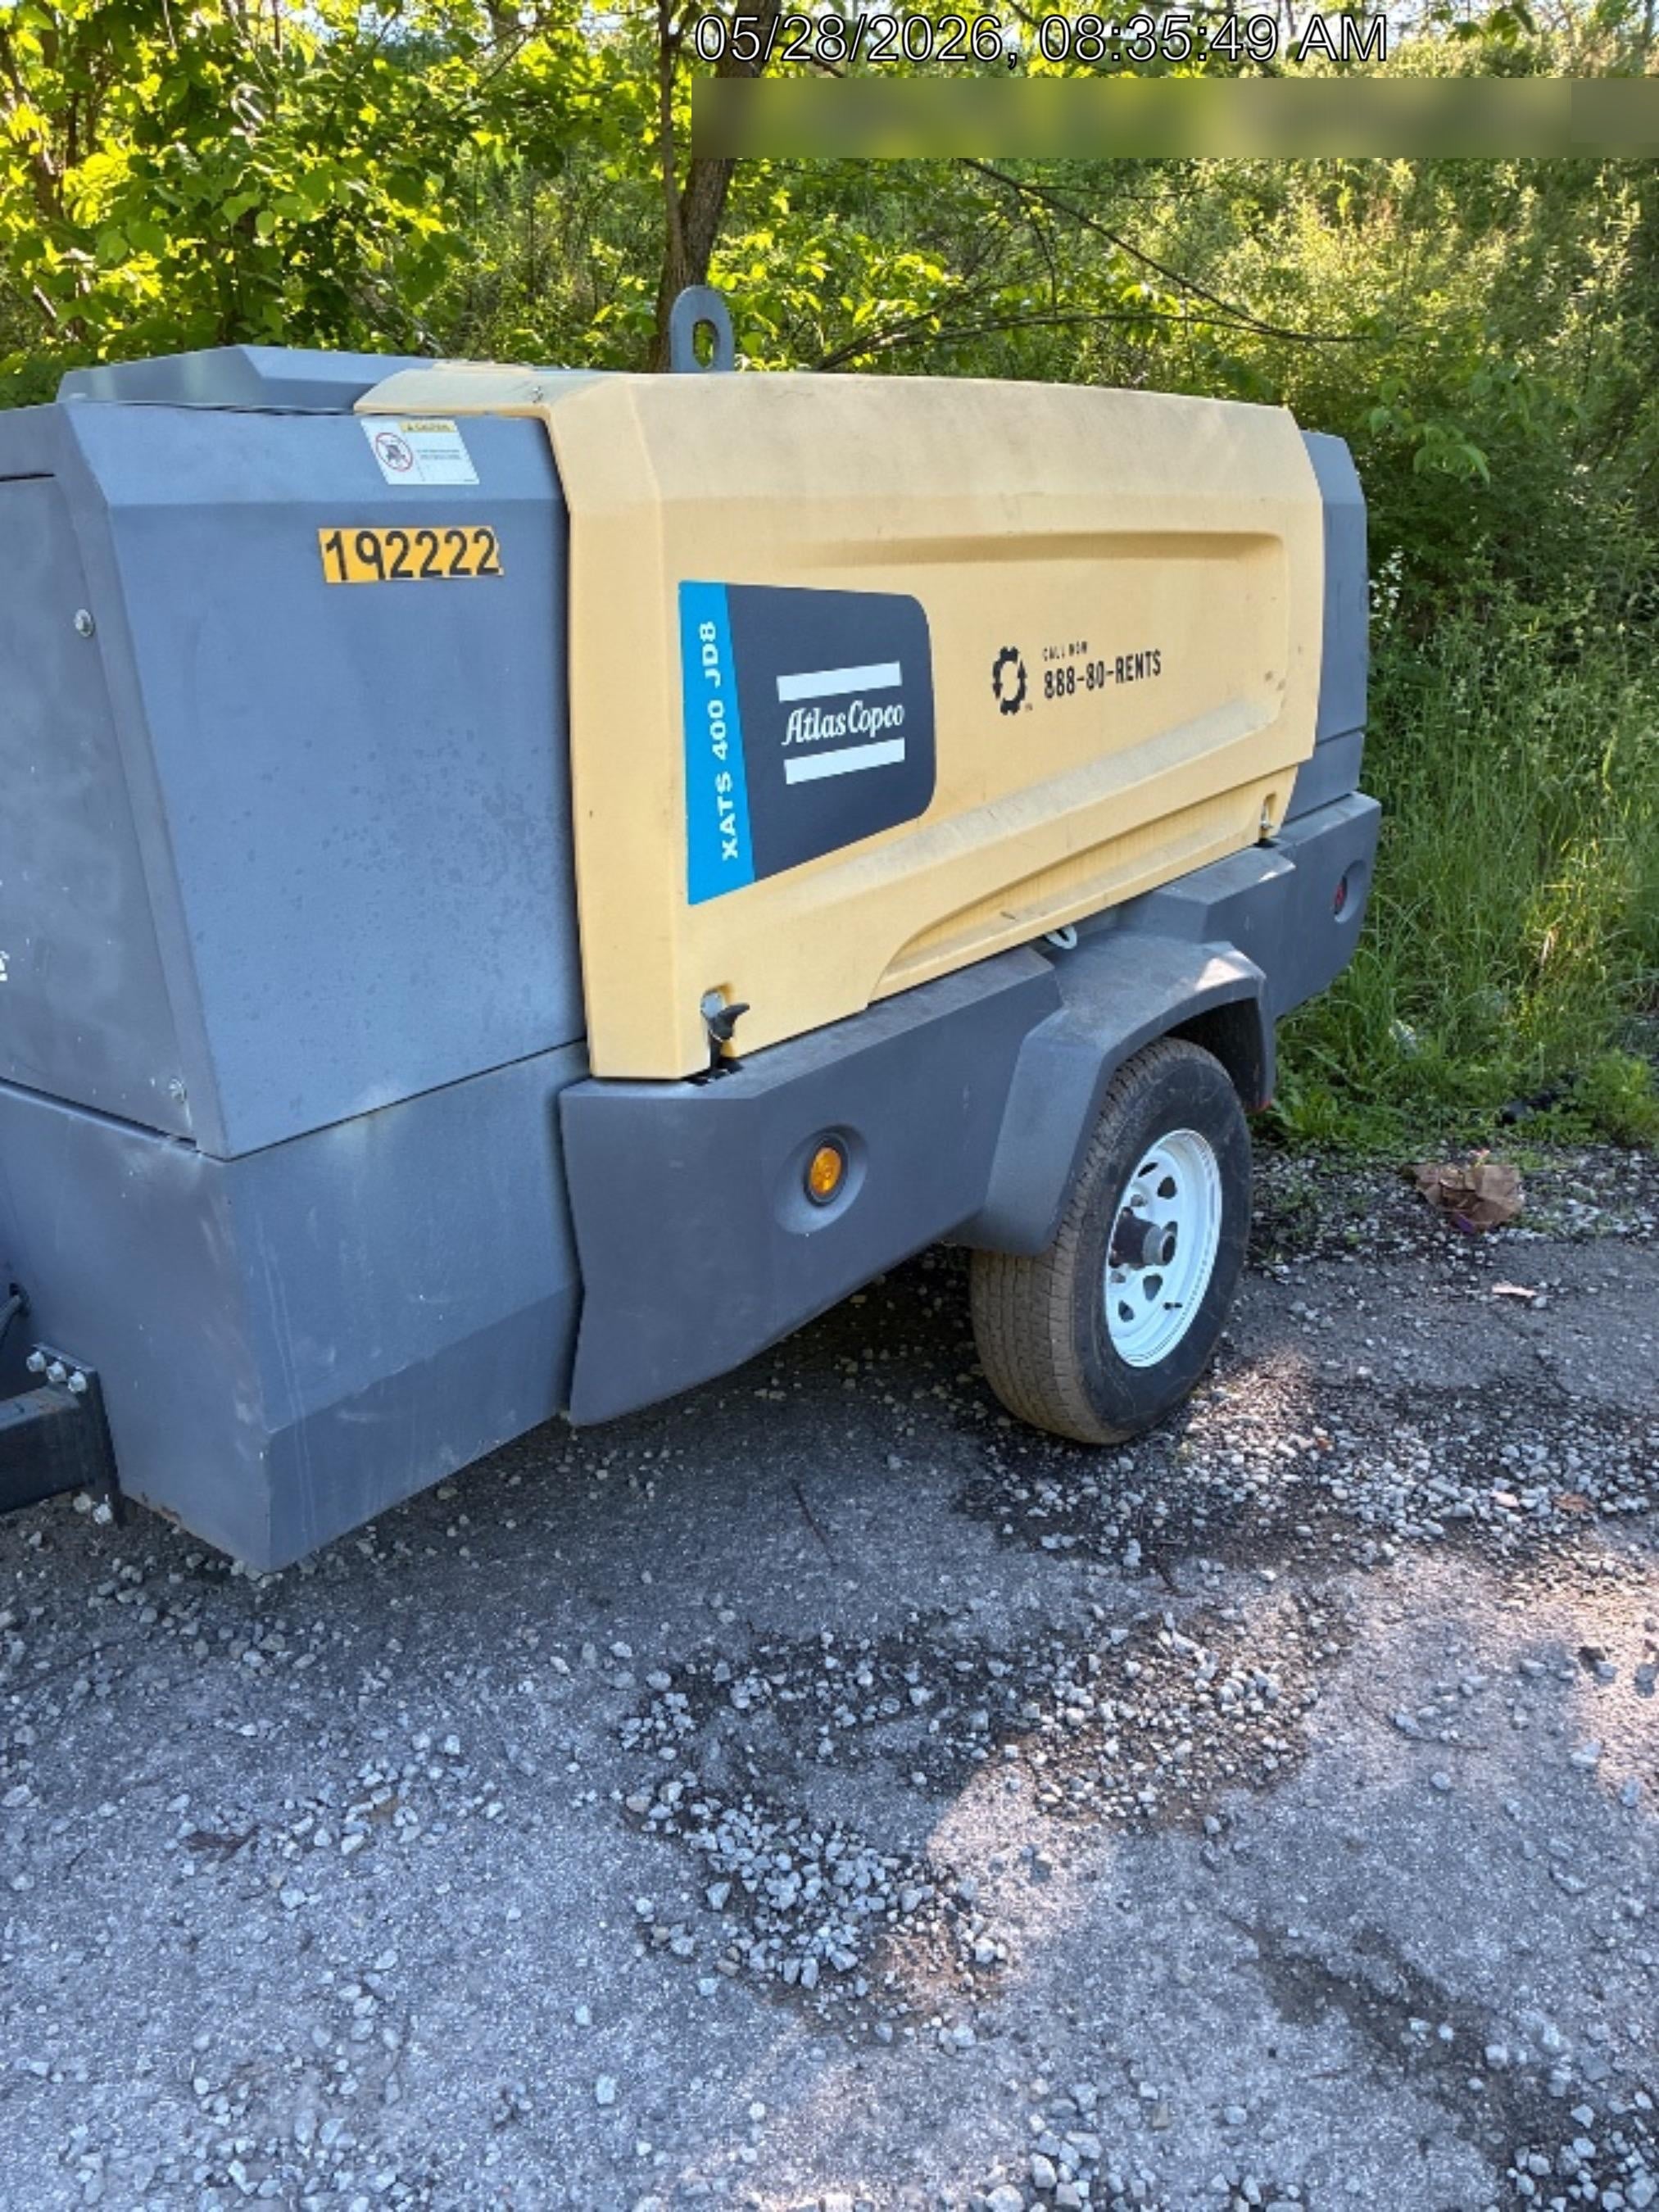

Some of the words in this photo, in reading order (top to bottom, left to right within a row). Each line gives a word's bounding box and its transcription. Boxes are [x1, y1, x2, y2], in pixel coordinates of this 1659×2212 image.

[325, 528, 500, 581] 192222
[699, 621, 722, 688] JD8
[1044, 649, 1162, 699] 888-80-RENTS
[707, 700, 728, 760] 400
[715, 773, 738, 861] XATS
